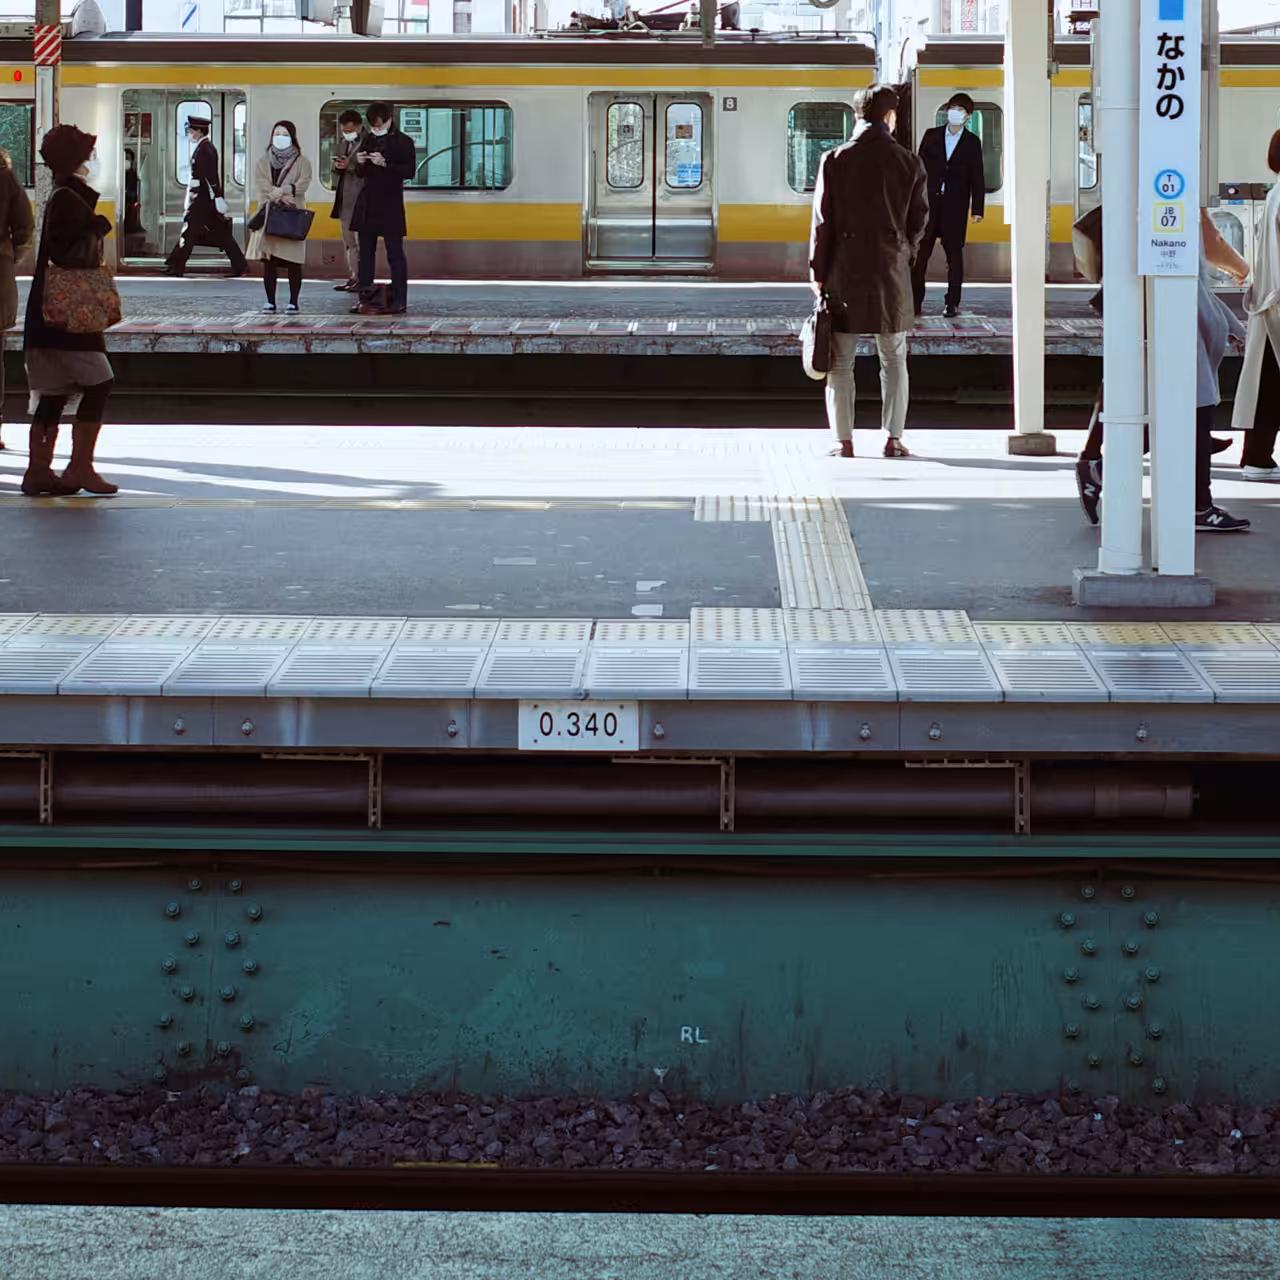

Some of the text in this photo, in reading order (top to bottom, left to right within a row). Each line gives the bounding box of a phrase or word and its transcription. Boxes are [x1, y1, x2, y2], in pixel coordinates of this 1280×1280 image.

[1156, 32, 1185, 120] なかの
[1162, 183, 1175, 192] 01
[1161, 215, 1177, 227] 07
[1151, 239, 1187, 248] Nakano
[540, 712, 617, 736] 0.340
[681, 1026, 709, 1043] RL
